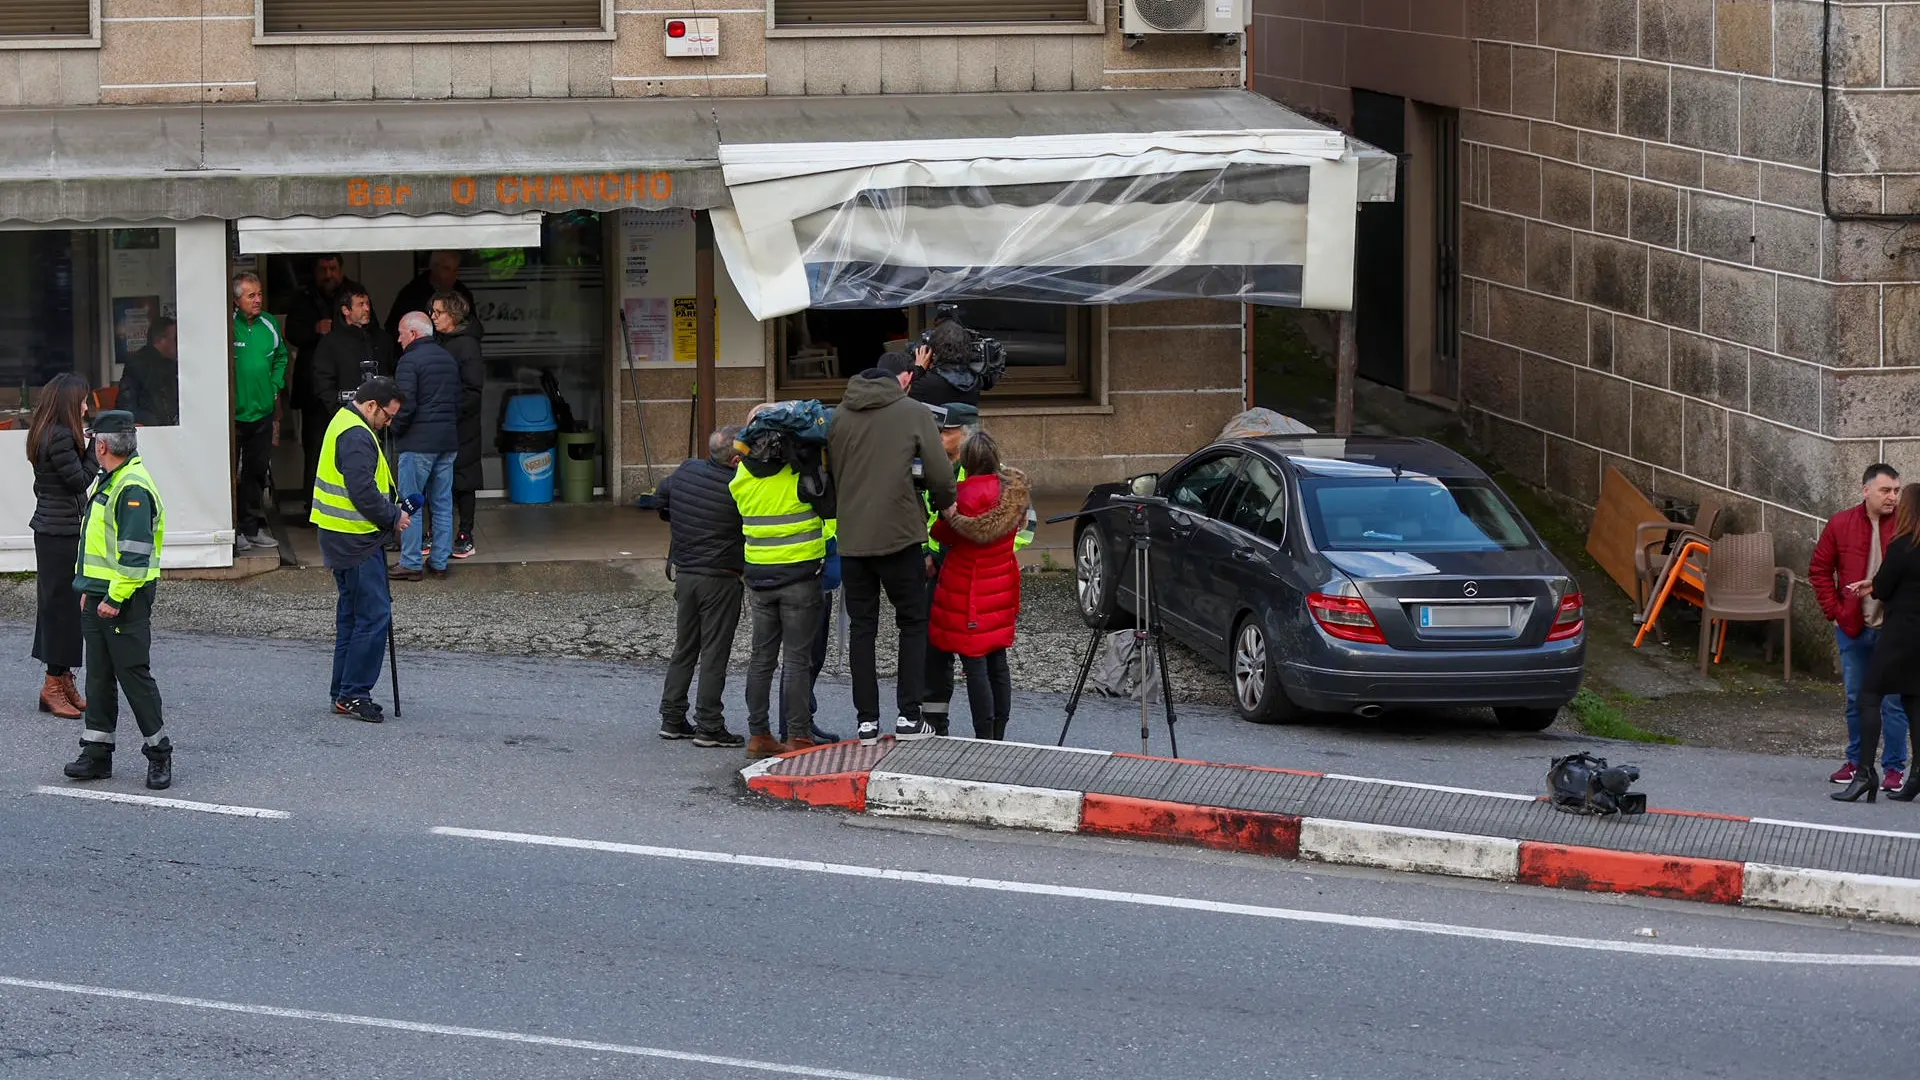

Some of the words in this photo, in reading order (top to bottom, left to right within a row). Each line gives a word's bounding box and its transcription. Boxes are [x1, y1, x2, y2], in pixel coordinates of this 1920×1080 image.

[347, 177, 412, 206] Bar
[452, 176, 476, 205] O
[496, 171, 673, 204] CHANCHO
